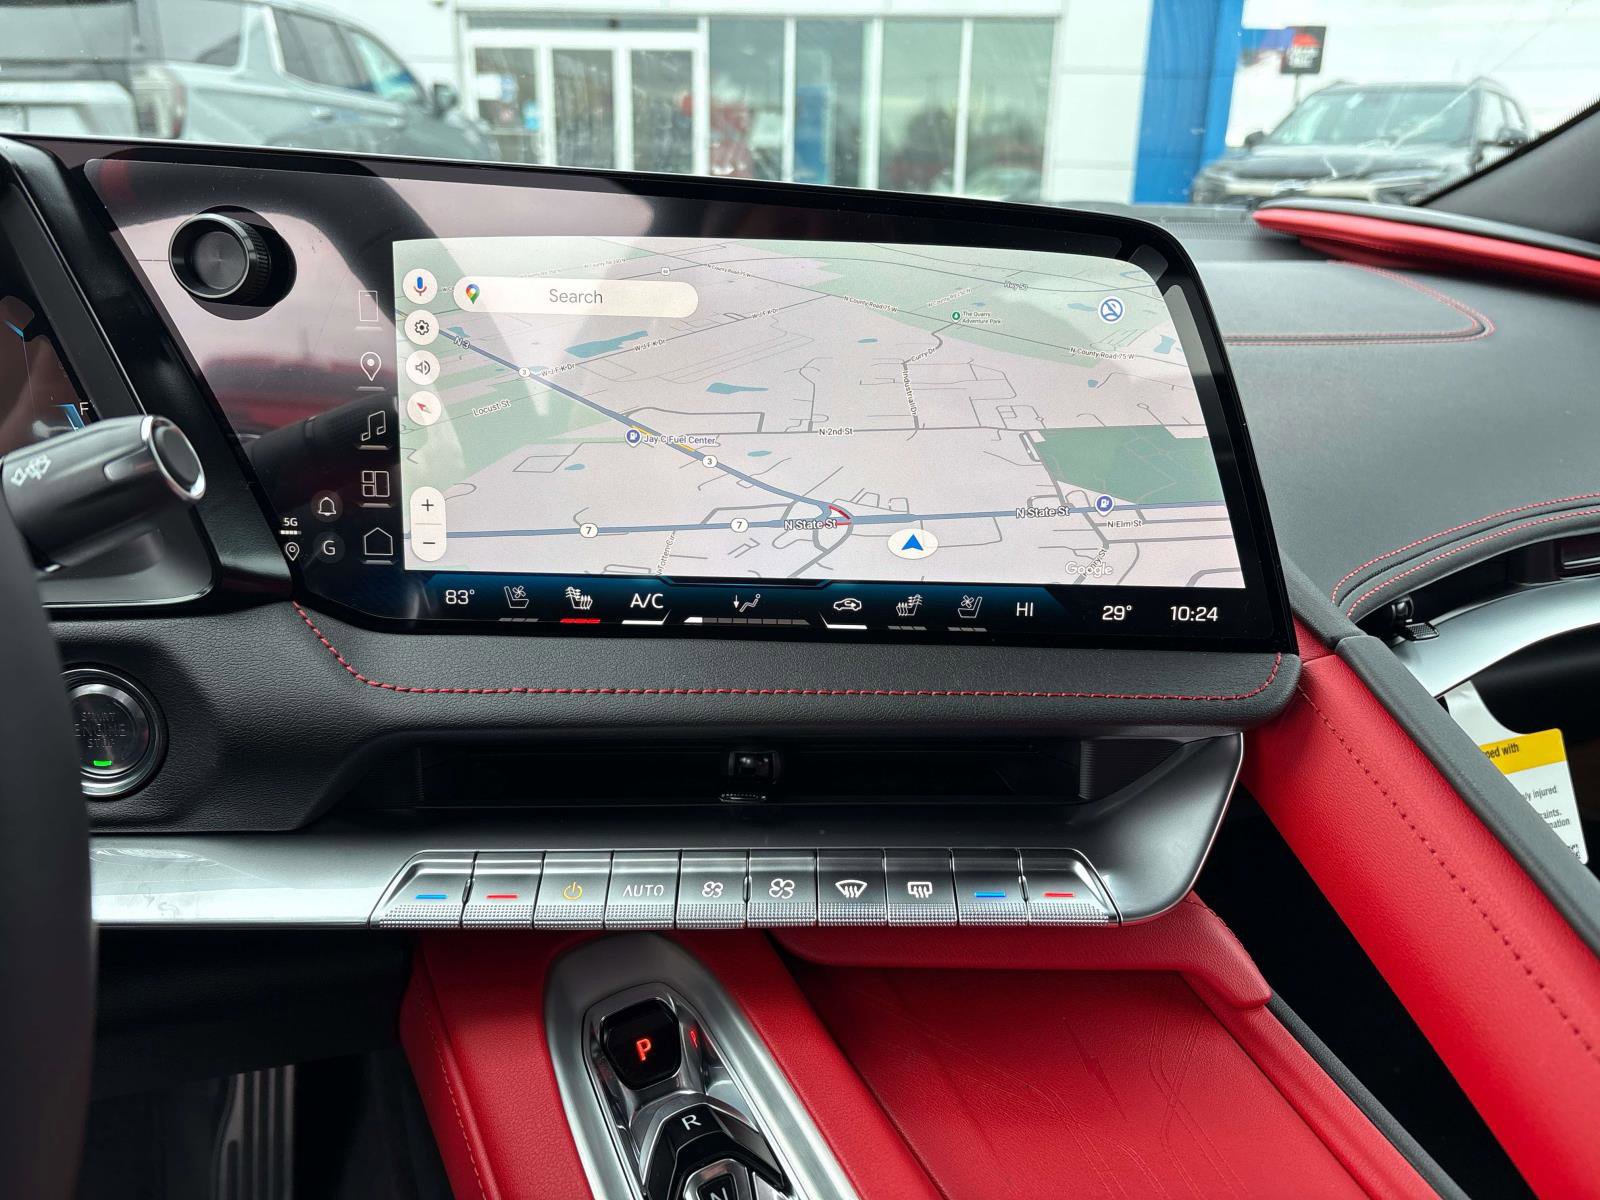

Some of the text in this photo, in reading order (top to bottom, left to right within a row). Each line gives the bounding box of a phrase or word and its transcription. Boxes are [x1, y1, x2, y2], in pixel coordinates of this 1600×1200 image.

[549, 288, 603, 304] Search
[911, 352, 928, 362] Curry
[1077, 349, 1100, 358] County
[1100, 352, 1117, 360] Road
[902, 370, 915, 406] Industrial
[79, 401, 89, 416] F
[473, 399, 511, 416] Locust St
[819, 426, 853, 437] N 2nd St
[644, 435, 659, 444] Jay
[669, 435, 687, 444] Fuel
[688, 436, 716, 445] Center
[1016, 505, 1070, 519] N State St
[284, 517, 298, 527] 5G
[784, 519, 837, 531] N State St
[1107, 519, 1142, 529] N Elm St
[323, 540, 336, 555] G
[1065, 561, 1113, 579] Google
[445, 589, 475, 605] 83°
[629, 593, 664, 610] A/C
[1016, 602, 1034, 617] HI
[1102, 604, 1132, 621] 29°
[1170, 606, 1219, 622] 10:24
[1502, 743, 1520, 756] with
[1532, 786, 1557, 799] injured
[1541, 808, 1562, 819] aints.
[622, 884, 665, 897] AUTO
[636, 1038, 651, 1061] P
[681, 1114, 702, 1131] R
